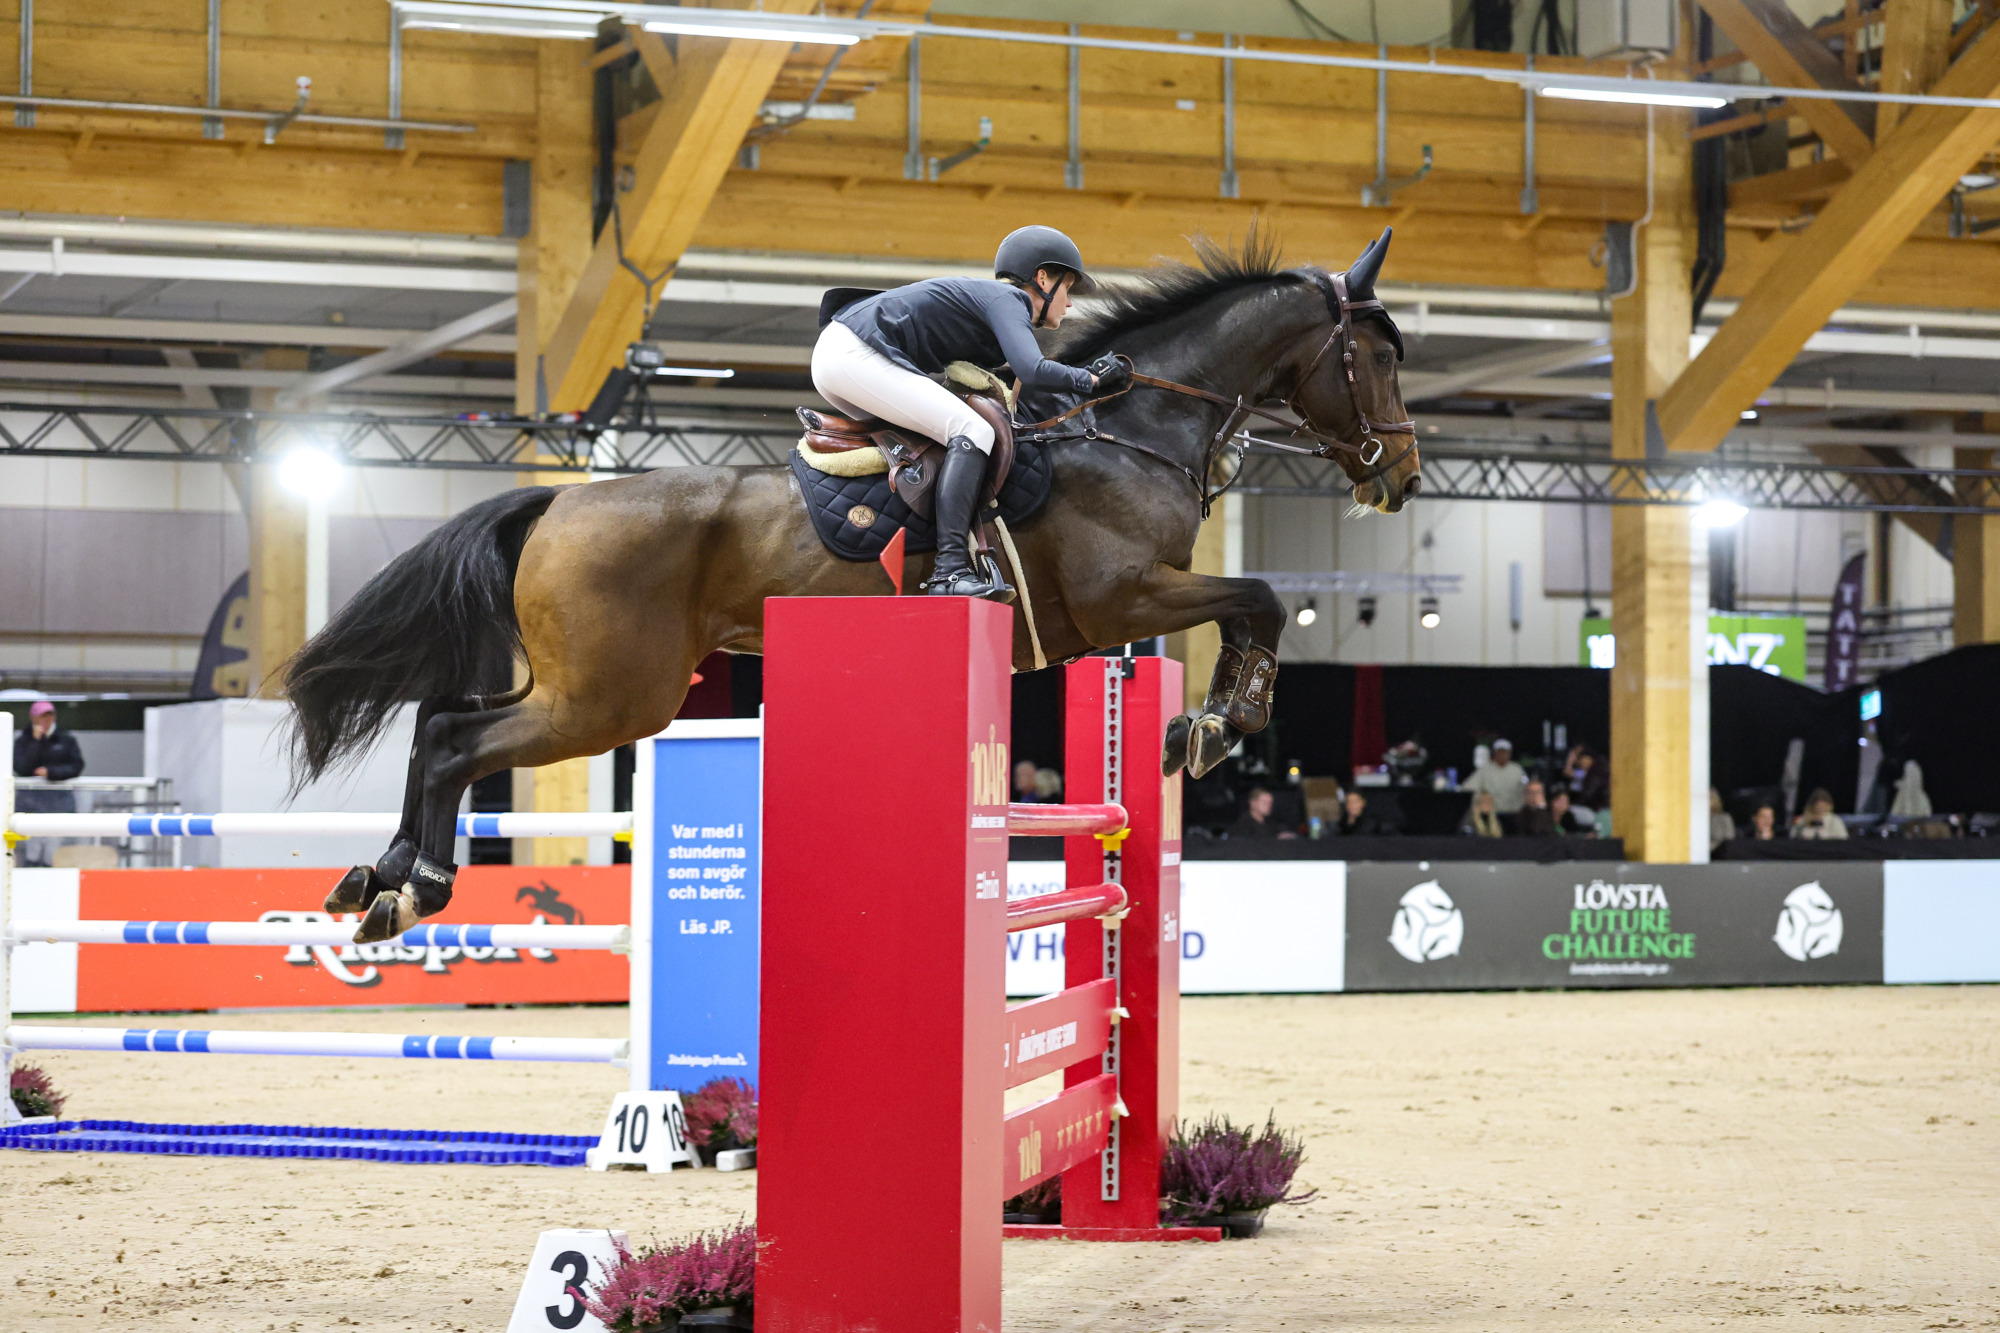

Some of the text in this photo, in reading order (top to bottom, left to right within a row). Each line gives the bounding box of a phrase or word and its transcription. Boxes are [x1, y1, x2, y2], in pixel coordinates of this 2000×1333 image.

[671, 822, 744, 839] Var med i
[668, 844, 746, 859] stunderna
[667, 863, 747, 883] som avgör
[667, 884, 746, 900] och berör.
[1574, 879, 1669, 910] LÖVSTA
[680, 919, 734, 935] Läs JP.
[1570, 909, 1671, 935] FUTURE
[1542, 933, 1697, 960] CHALLENGE
[614, 1104, 649, 1154] 10
[662, 1103, 687, 1152] 10
[545, 1250, 589, 1330] 3
